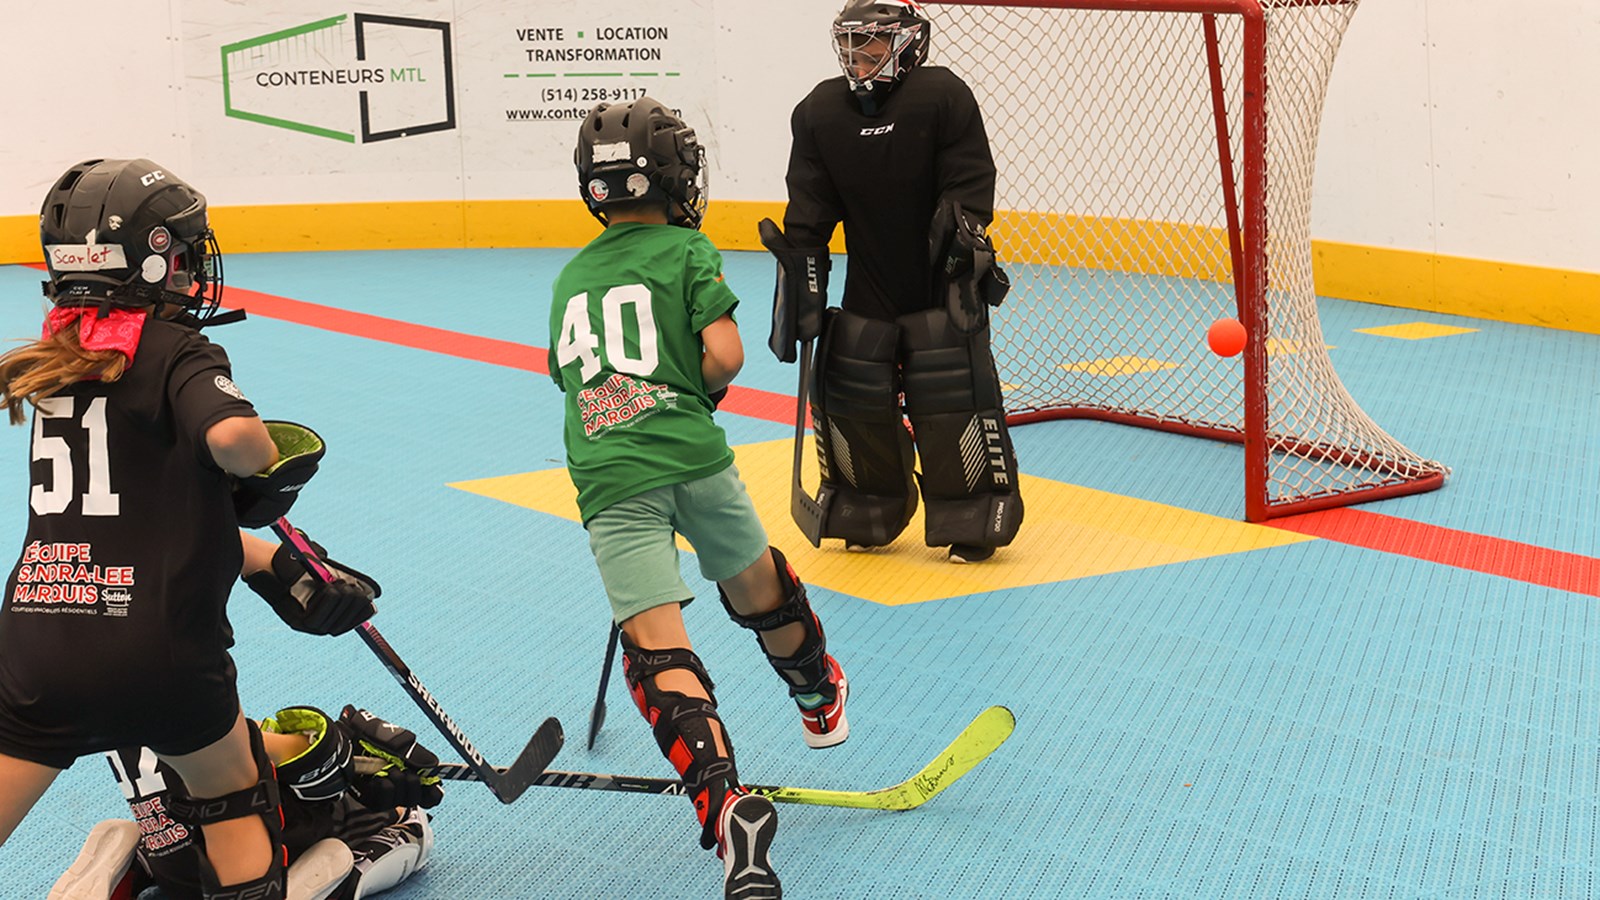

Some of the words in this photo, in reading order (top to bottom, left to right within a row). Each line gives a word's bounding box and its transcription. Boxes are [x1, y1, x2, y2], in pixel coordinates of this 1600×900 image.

[516, 28, 564, 41] VENTE
[596, 27, 668, 40] LOCATION
[526, 48, 661, 62] TRANSFORMATION
[256, 68, 385, 87] CONTENEURS
[390, 68, 426, 83] MTL
[541, 88, 578, 101] (514)
[582, 88, 647, 101] 258-9117
[860, 123, 895, 136] CCM
[54, 246, 112, 265] Scarlet
[806, 256, 818, 293] ELITE
[557, 283, 659, 385] 40
[29, 396, 121, 516] 51
[983, 419, 1009, 485] ELITE
